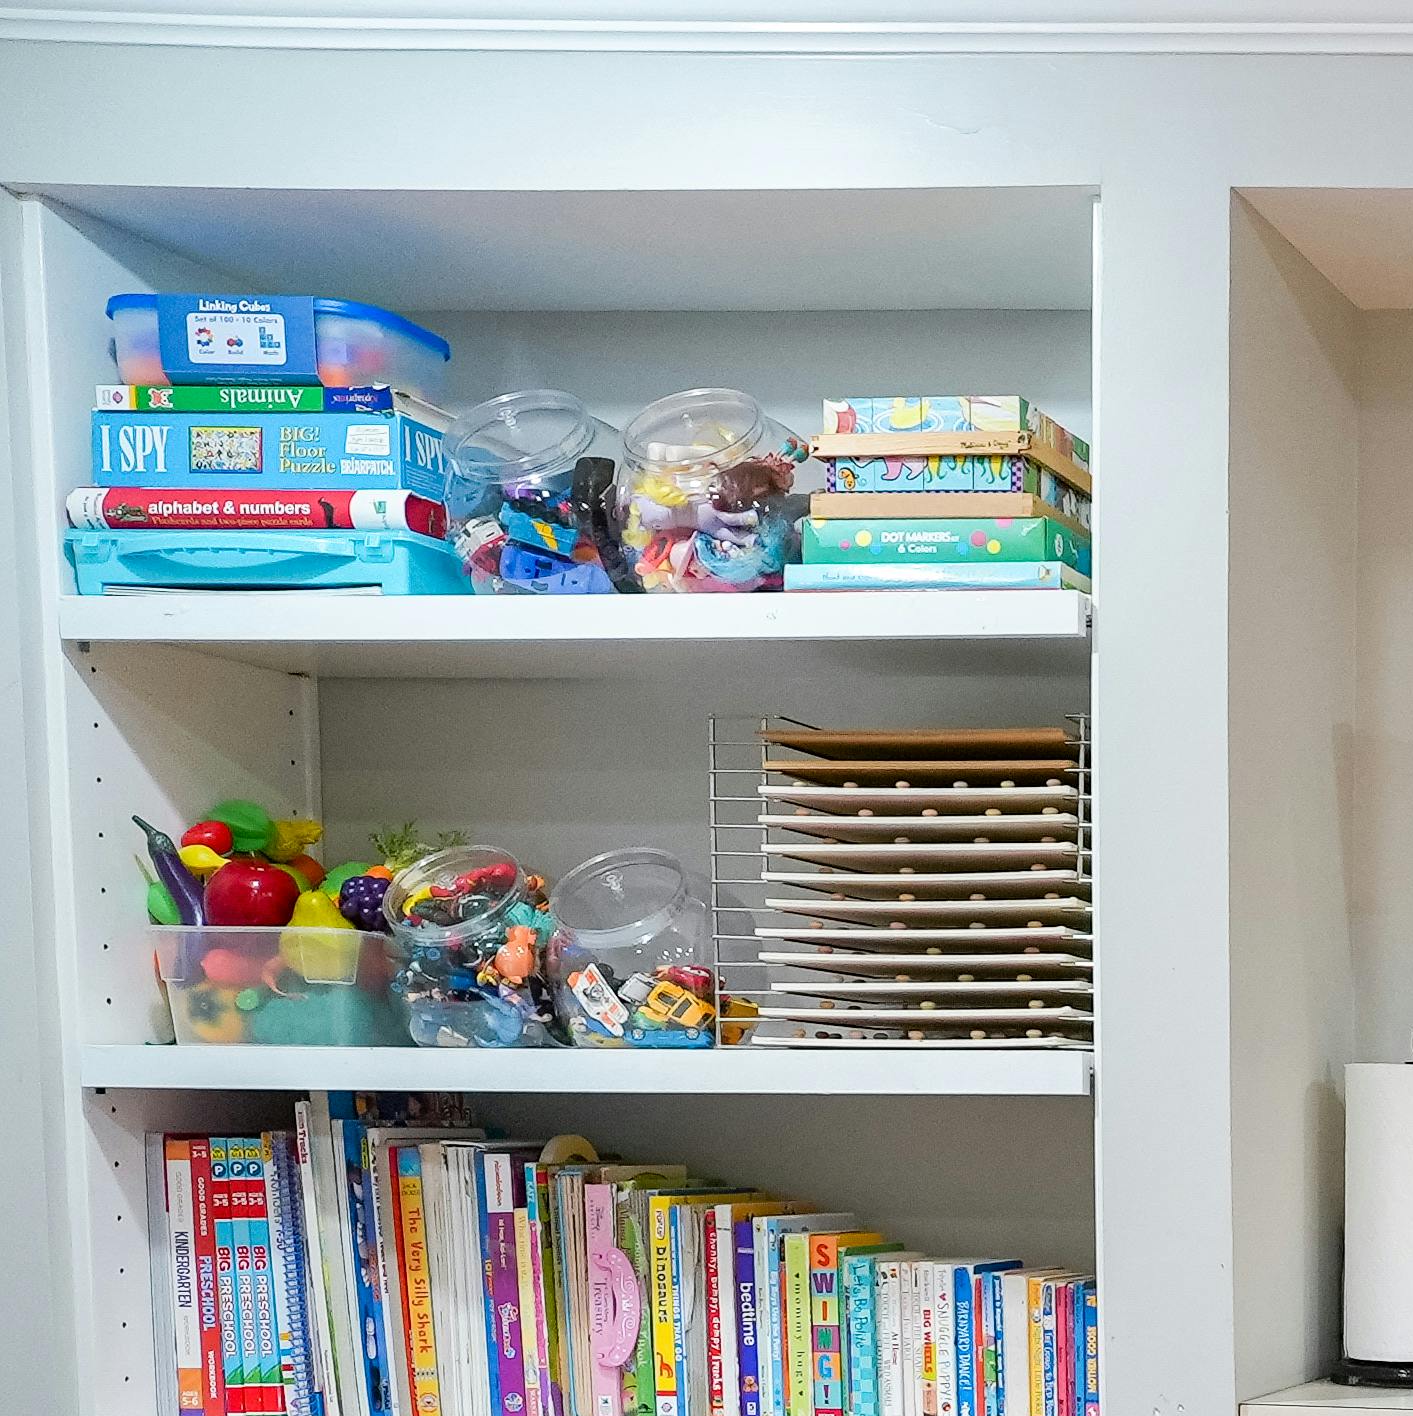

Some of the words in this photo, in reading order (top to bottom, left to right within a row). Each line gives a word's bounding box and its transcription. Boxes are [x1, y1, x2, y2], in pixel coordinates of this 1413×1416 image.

[199, 299, 238, 313] Linking
[238, 300, 271, 312] Cubes
[208, 315, 218, 323] of
[252, 316, 279, 324] Colors
[219, 388, 303, 409] Animals
[100, 424, 112, 472] I
[118, 424, 172, 473] SPY
[279, 426, 321, 442] BIG!
[404, 425, 411, 462] I
[279, 443, 327, 458] Floor
[279, 458, 336, 474] Puzzle
[147, 500, 219, 516] alphabet
[222, 501, 236, 514] &
[239, 501, 311, 515] numbers
[880, 531, 904, 543] DOT
[905, 531, 951, 543] MARKERS
[898, 545, 906, 553] 6
[908, 544, 938, 553] Colors
[215, 1166, 224, 1176] P
[233, 1164, 242, 1174] P
[249, 1164, 258, 1174] P
[198, 1176, 206, 1201] GOOD
[199, 1202, 208, 1237] GRADES
[408, 1208, 420, 1233] The
[174, 1231, 193, 1308] KINDERGARTEN
[218, 1246, 231, 1271] BIG
[236, 1246, 250, 1271] BIG
[253, 1246, 266, 1271] BIG
[409, 1241, 423, 1272] Very
[199, 1256, 217, 1331] PRESCHOOL
[411, 1279, 428, 1306] Silly
[656, 1246, 669, 1324] Dinosaurs
[853, 1264, 867, 1295] Let's
[221, 1276, 237, 1358] PRESCHOOL
[239, 1275, 256, 1358] PRESCHOOL
[256, 1275, 273, 1358] PRESCHOOL
[593, 1281, 608, 1335] Treasury
[740, 1282, 757, 1346] bedtime
[793, 1283, 804, 1341] mommy
[854, 1299, 868, 1312] Be
[923, 1309, 931, 1327] BIG
[418, 1313, 433, 1353] Shark
[813, 1243, 835, 1404] SWING!
[854, 1316, 868, 1349] Polite
[937, 1303, 950, 1357] SNUGGLE
[957, 1300, 970, 1350] BARNYARD
[674, 1347, 683, 1361] GO
[924, 1331, 932, 1373] WHEELS
[939, 1361, 951, 1400] PUPPY!
[960, 1353, 973, 1390] DANCE!
